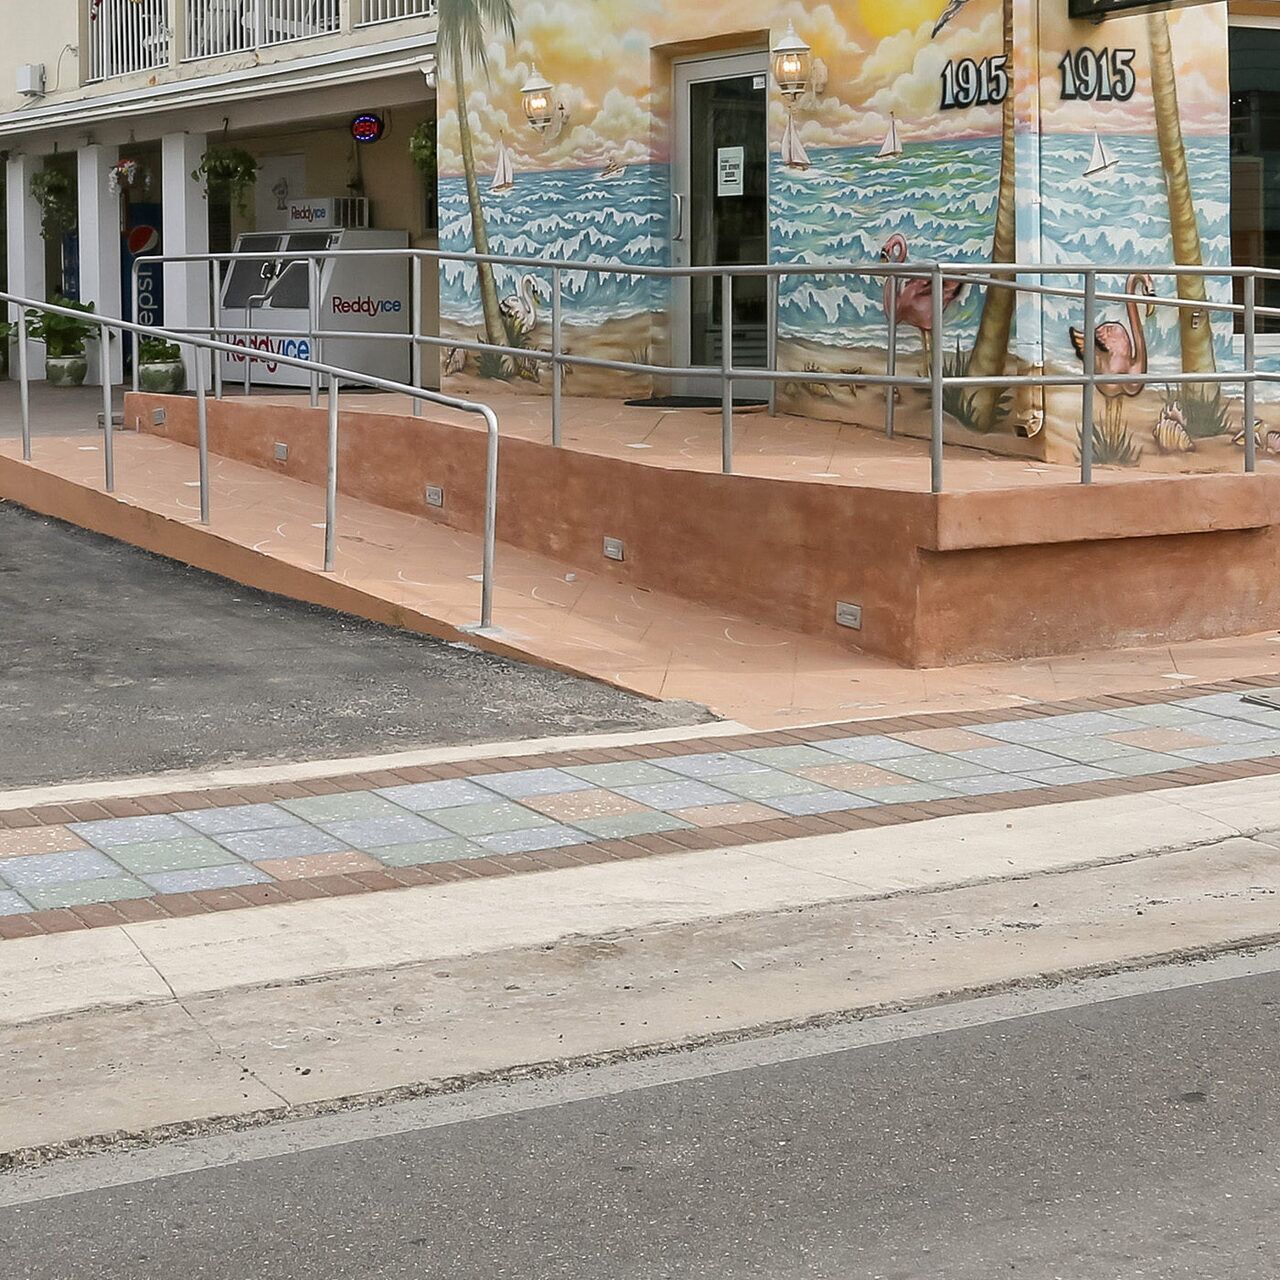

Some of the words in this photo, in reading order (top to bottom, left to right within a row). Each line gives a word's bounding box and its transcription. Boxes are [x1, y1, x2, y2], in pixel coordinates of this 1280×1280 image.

[940, 54, 1008, 110] 1915
[1058, 47, 1136, 102] 1915
[352, 122, 378, 135] OPEN
